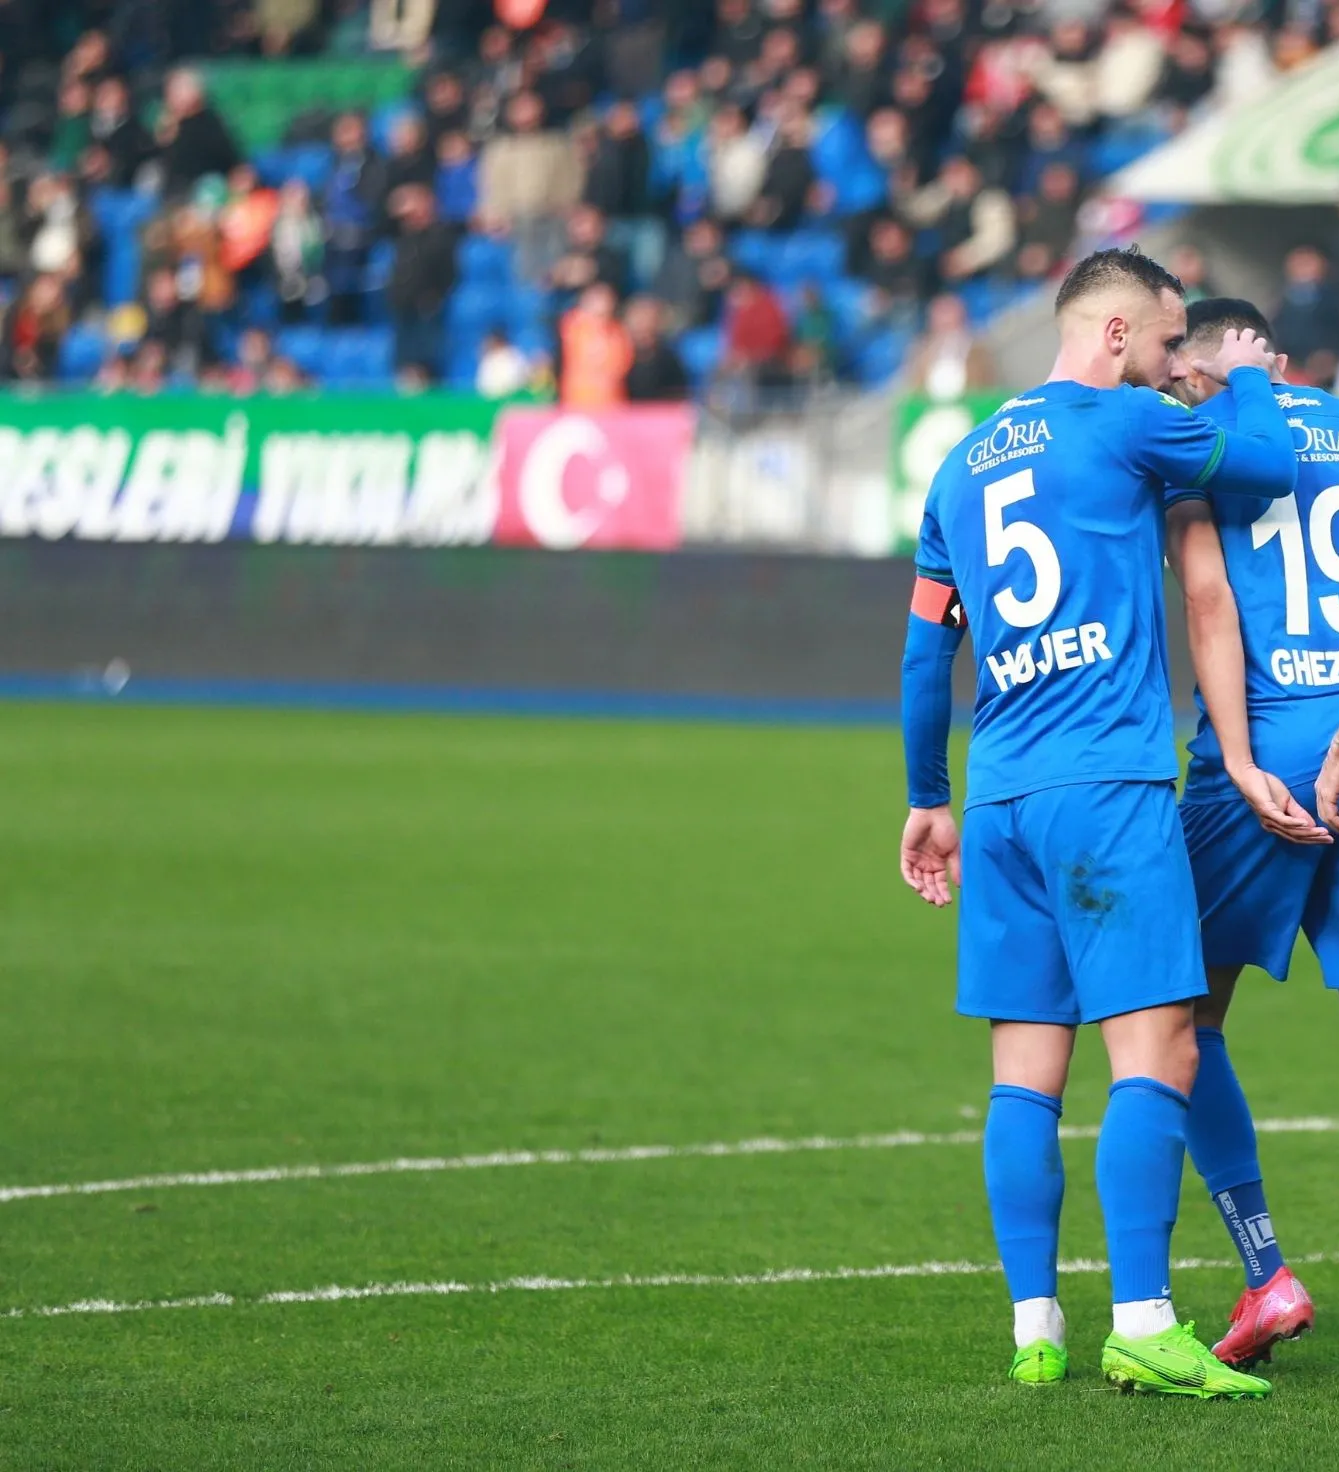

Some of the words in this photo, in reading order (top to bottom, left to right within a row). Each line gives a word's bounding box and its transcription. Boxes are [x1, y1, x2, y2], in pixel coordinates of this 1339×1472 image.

[966, 419, 1054, 466] GLORIA
[971, 456, 1001, 476] HOTELS
[999, 452, 1008, 463] &
[1007, 443, 1045, 460] RESORTS
[1301, 453, 1309, 462] &
[983, 468, 1062, 629] 5
[986, 622, 1113, 692] HØJER
[1230, 1212, 1264, 1277] TAPEDESIGN
